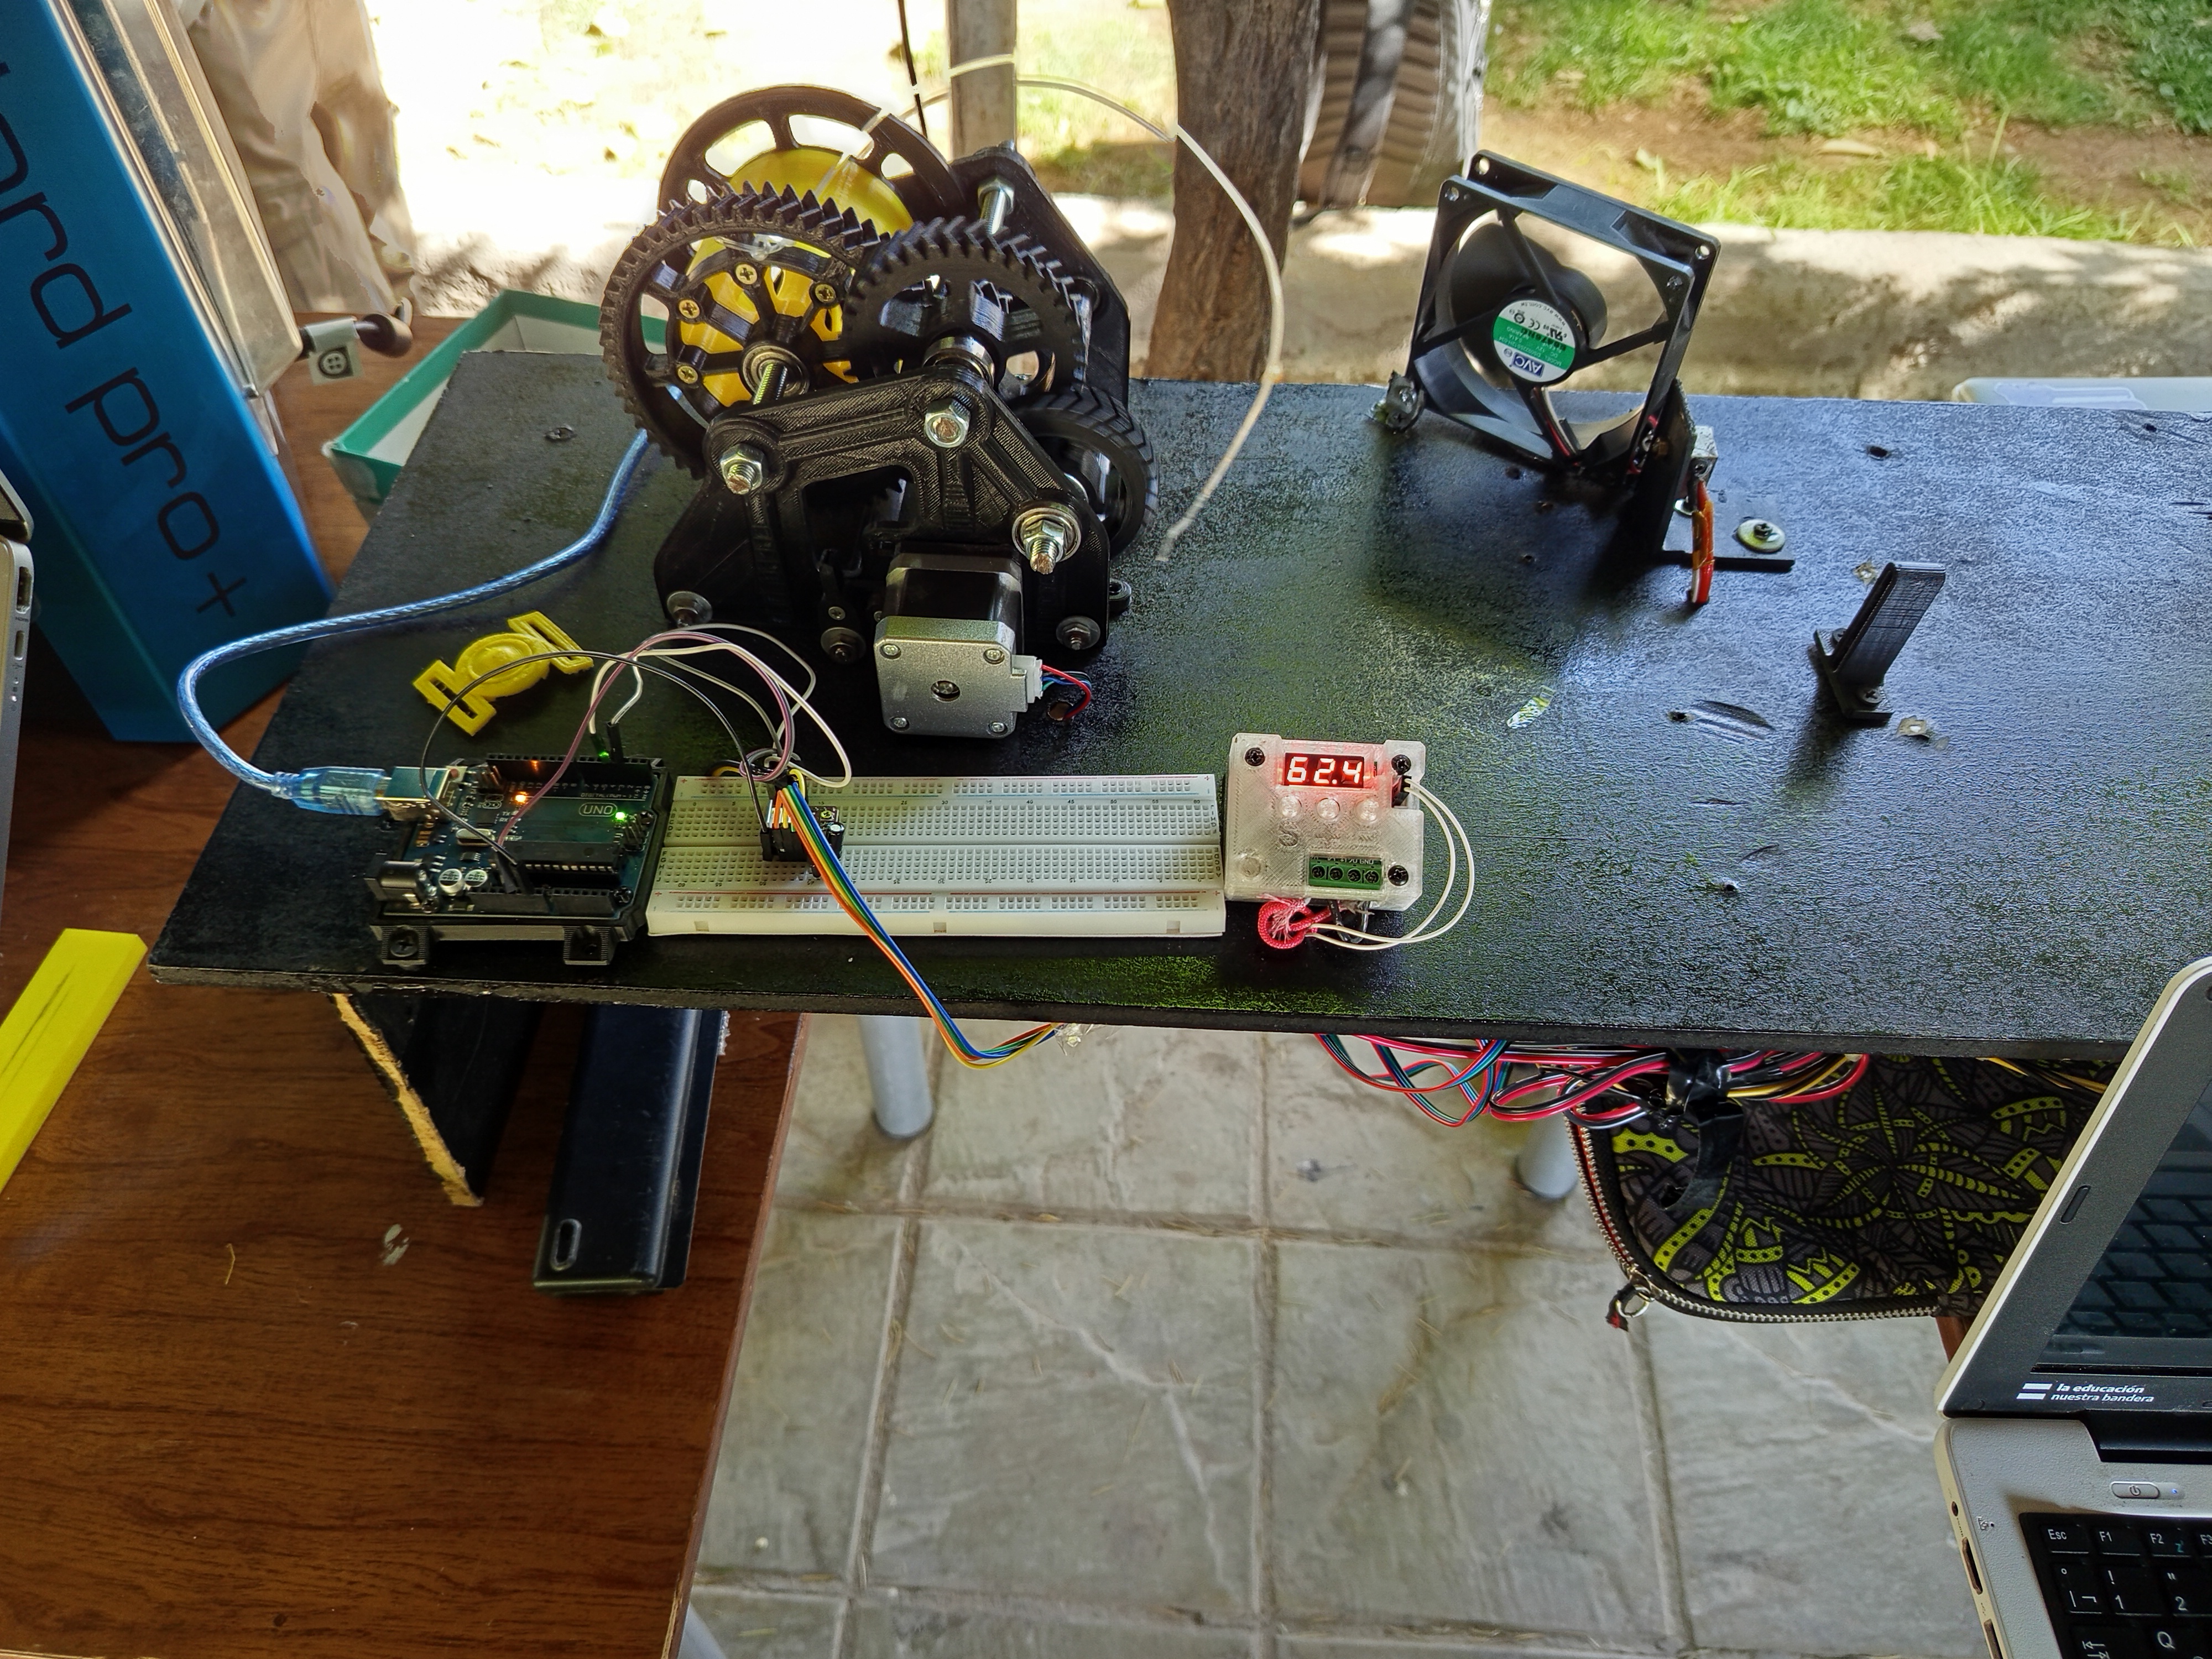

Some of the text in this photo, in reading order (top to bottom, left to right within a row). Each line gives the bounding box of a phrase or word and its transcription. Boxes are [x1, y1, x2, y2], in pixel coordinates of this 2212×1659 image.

[1515, 356, 1542, 374] AVC
[1545, 356, 1562, 367] MODEL
[1287, 757, 1363, 785] 62.4
[583, 805, 613, 815] UNO
[2056, 1384, 2145, 1394] la educación
[2102, 1394, 2154, 1402] bandera
[2048, 1528, 2067, 1540] Esc
[2099, 1531, 2112, 1542] F1
[2150, 1533, 2164, 1544] F2
[2115, 1594, 2125, 1610] 1
[2174, 1596, 2188, 1611] 2
[2157, 1631, 2176, 1650] Q
